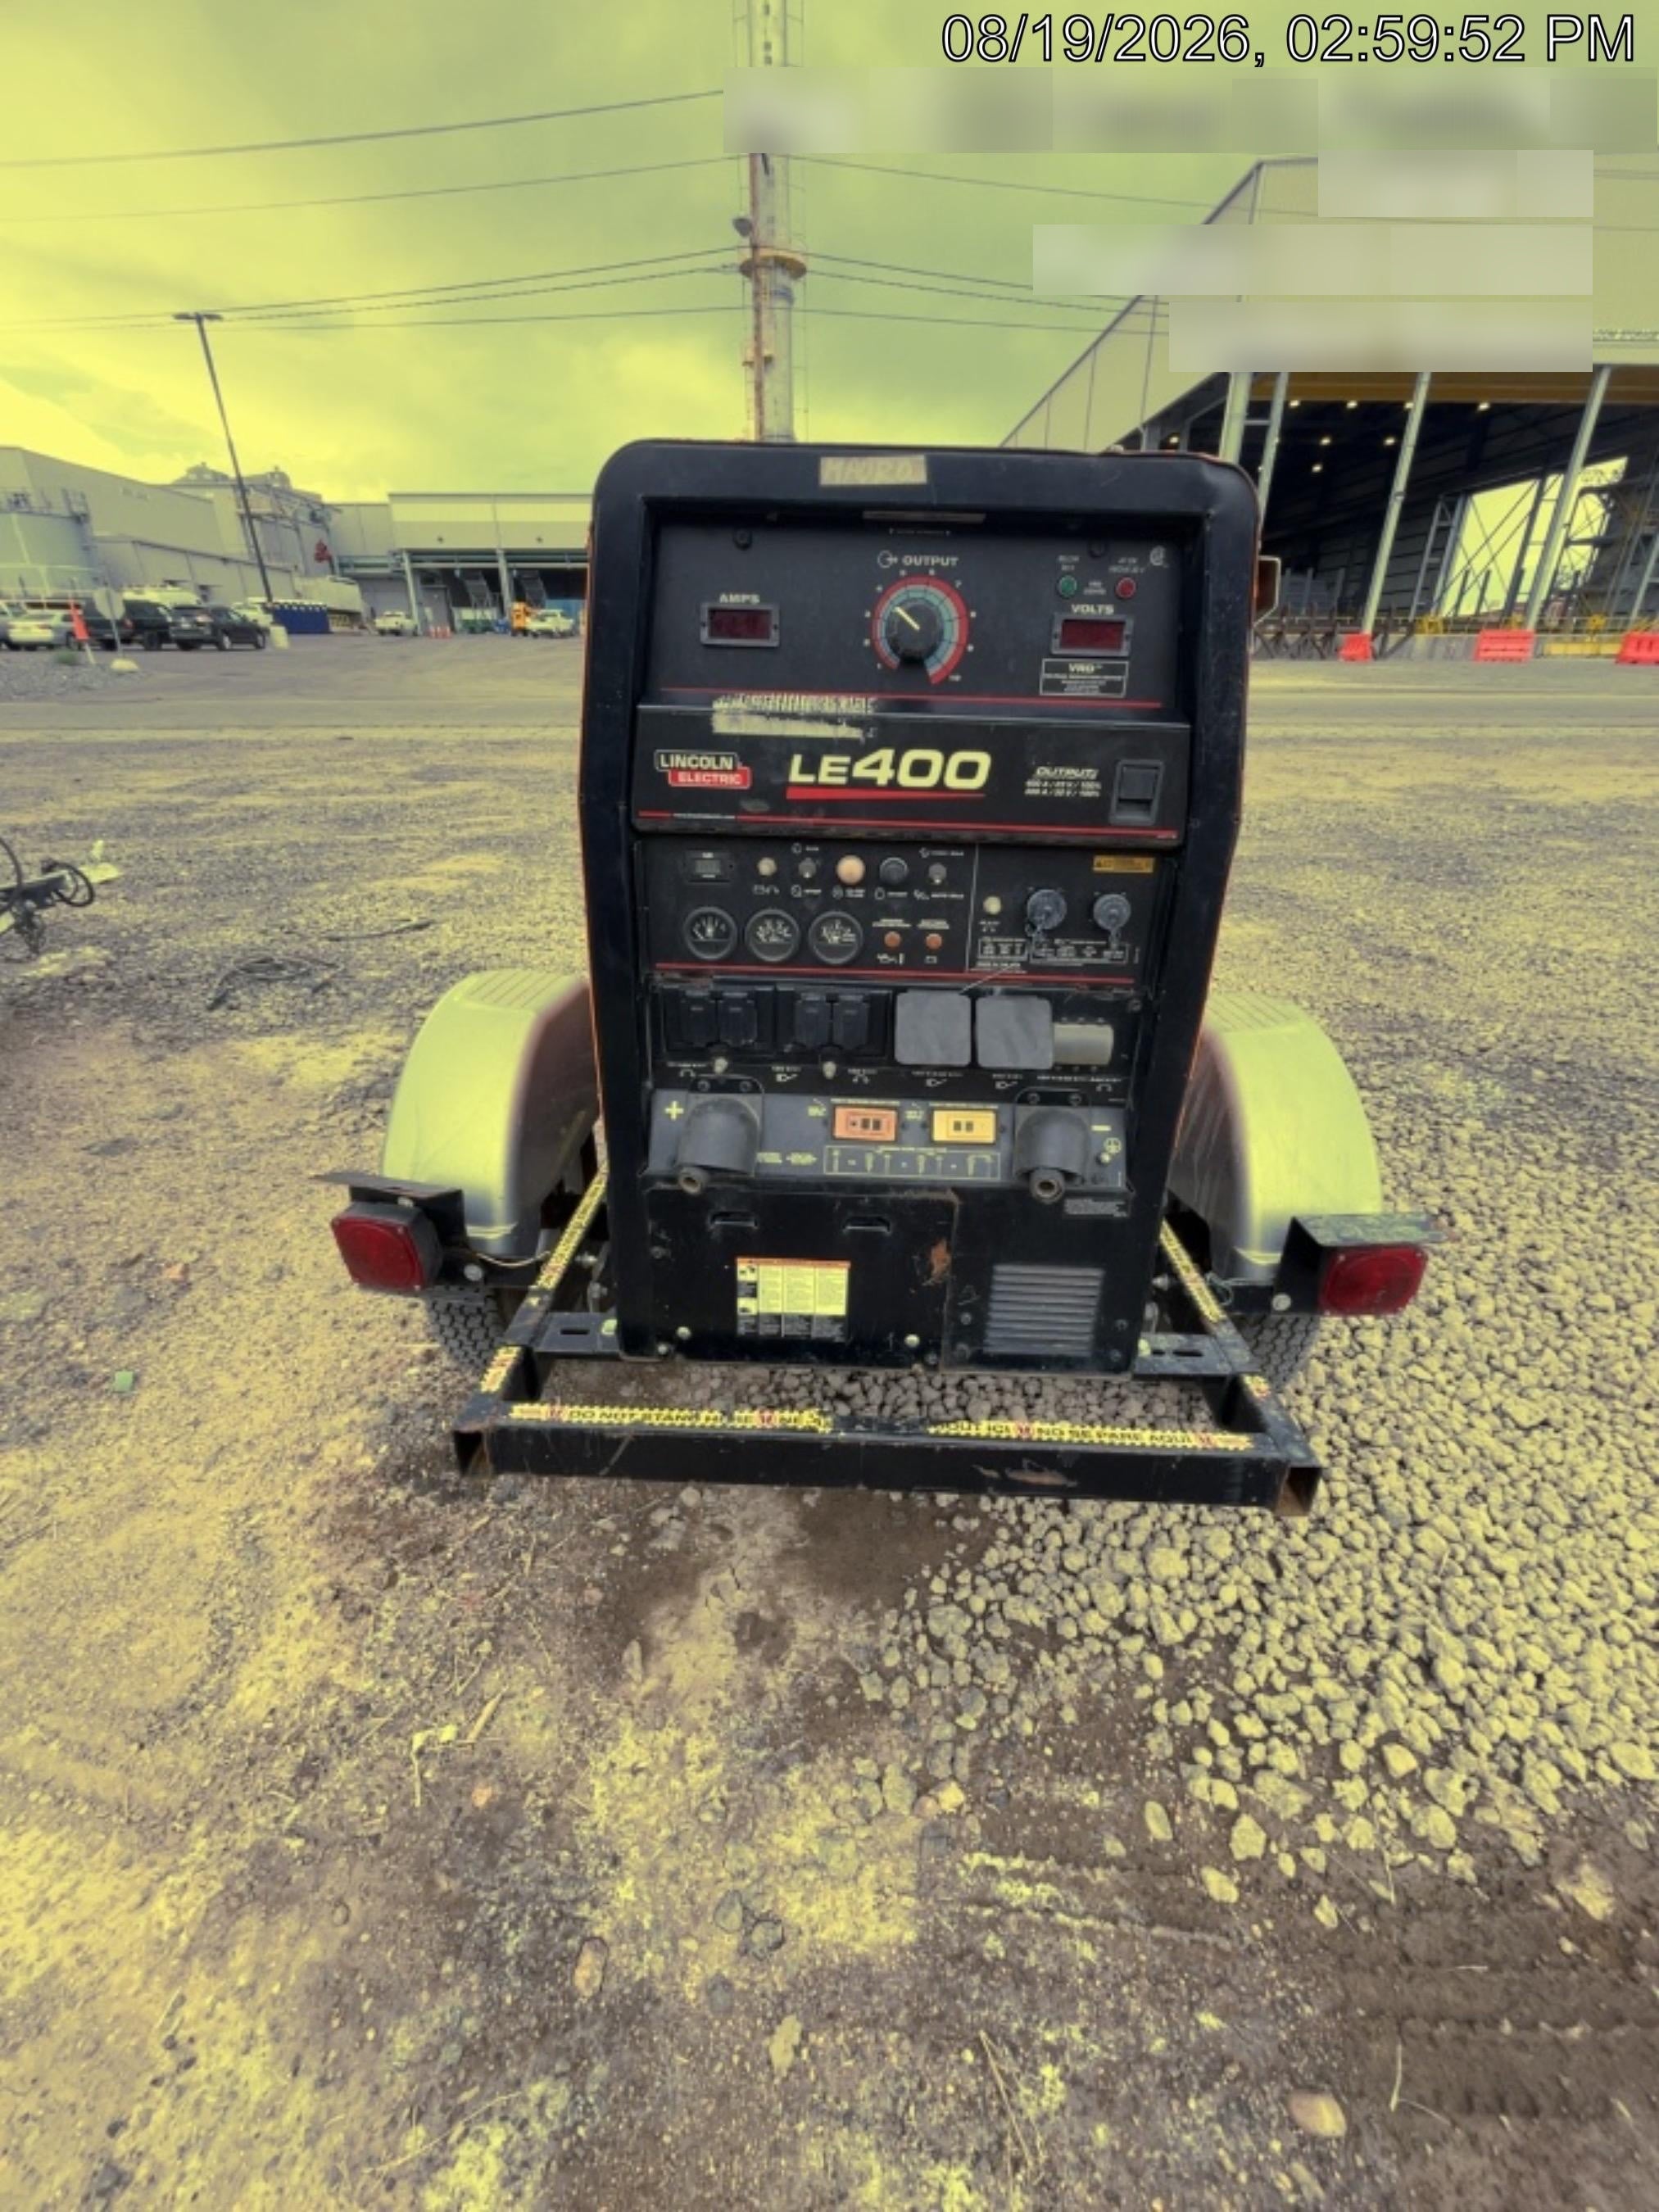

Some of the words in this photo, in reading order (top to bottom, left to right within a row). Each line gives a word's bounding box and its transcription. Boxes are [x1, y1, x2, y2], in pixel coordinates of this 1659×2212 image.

[902, 555, 959, 566] OUTPUT
[718, 592, 761, 605] AMPS
[1071, 604, 1115, 614] VOLTS
[660, 754, 734, 770] LINCOLN
[788, 749, 992, 790] LE400
[678, 772, 742, 786] ELECTRIC
[570, 1410, 596, 1420] DO
[600, 1412, 636, 1423] NOT
